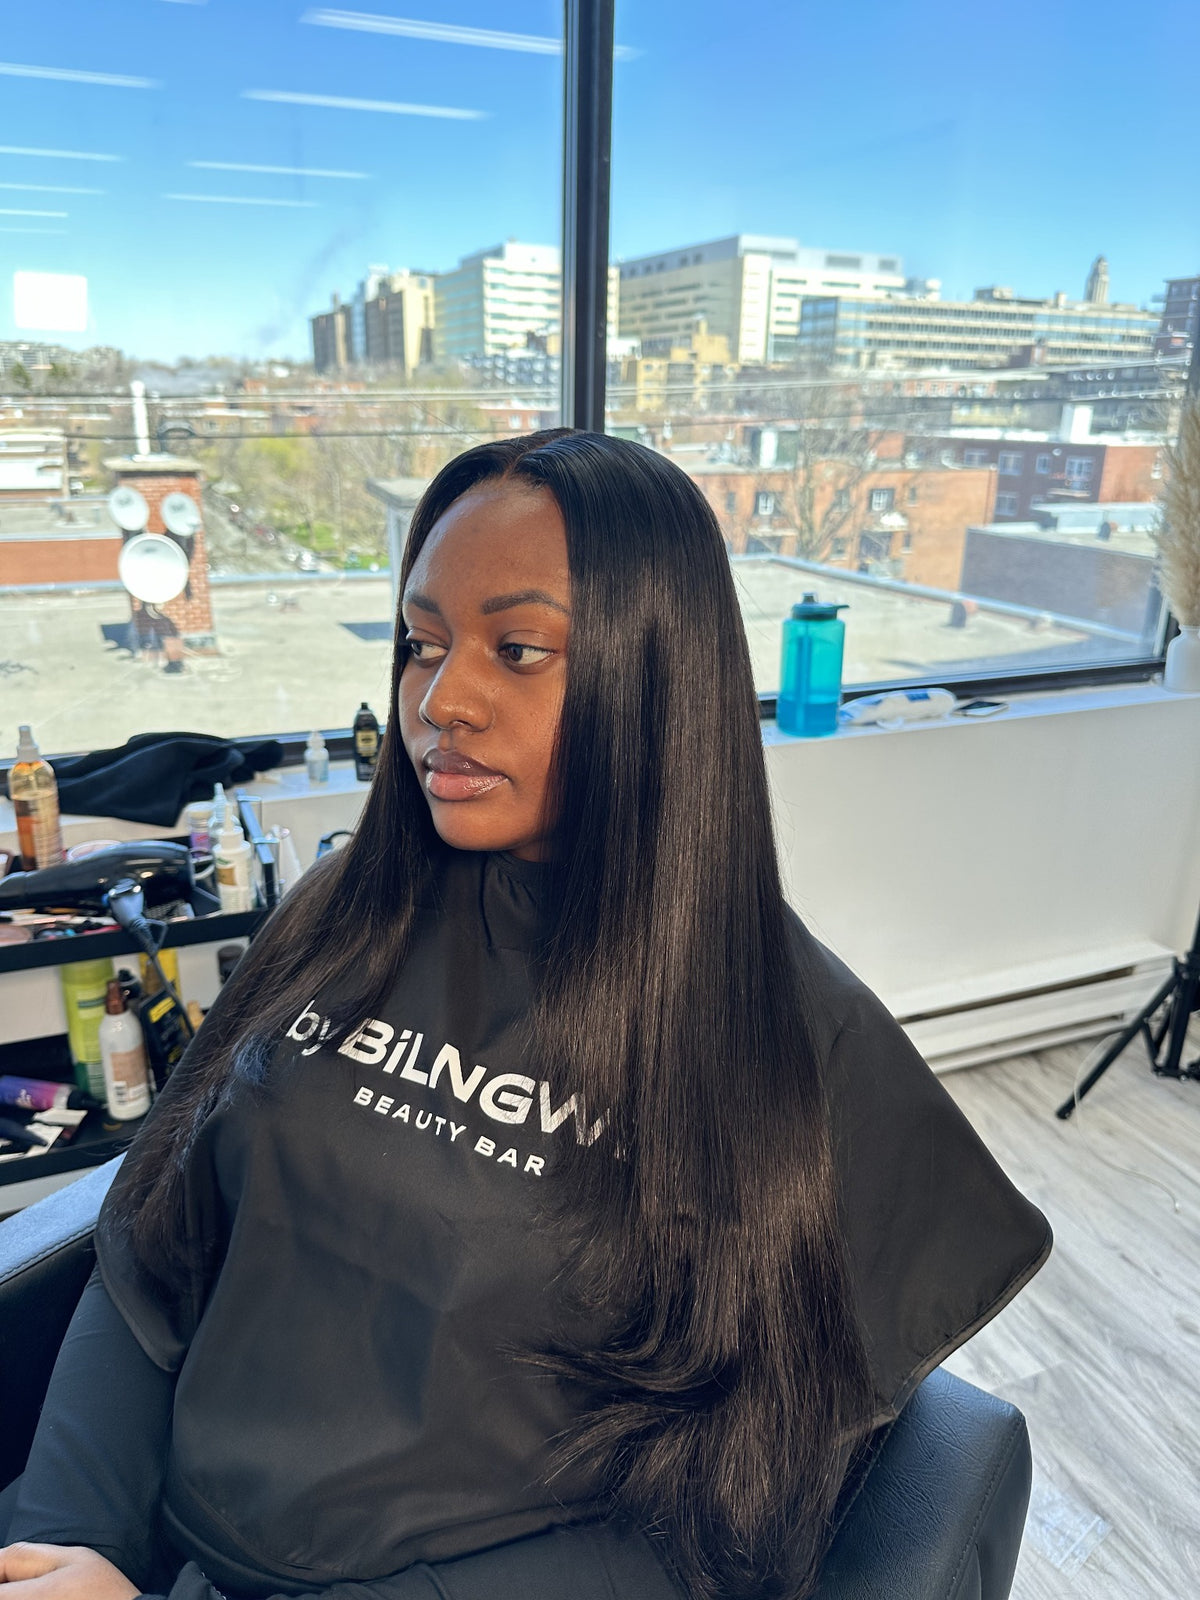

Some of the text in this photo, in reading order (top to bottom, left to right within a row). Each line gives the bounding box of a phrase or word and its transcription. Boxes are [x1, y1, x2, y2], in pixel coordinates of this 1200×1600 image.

[286, 1000, 626, 1162] by BiLNGW
[353, 1086, 546, 1176] BEAUTY BAR
